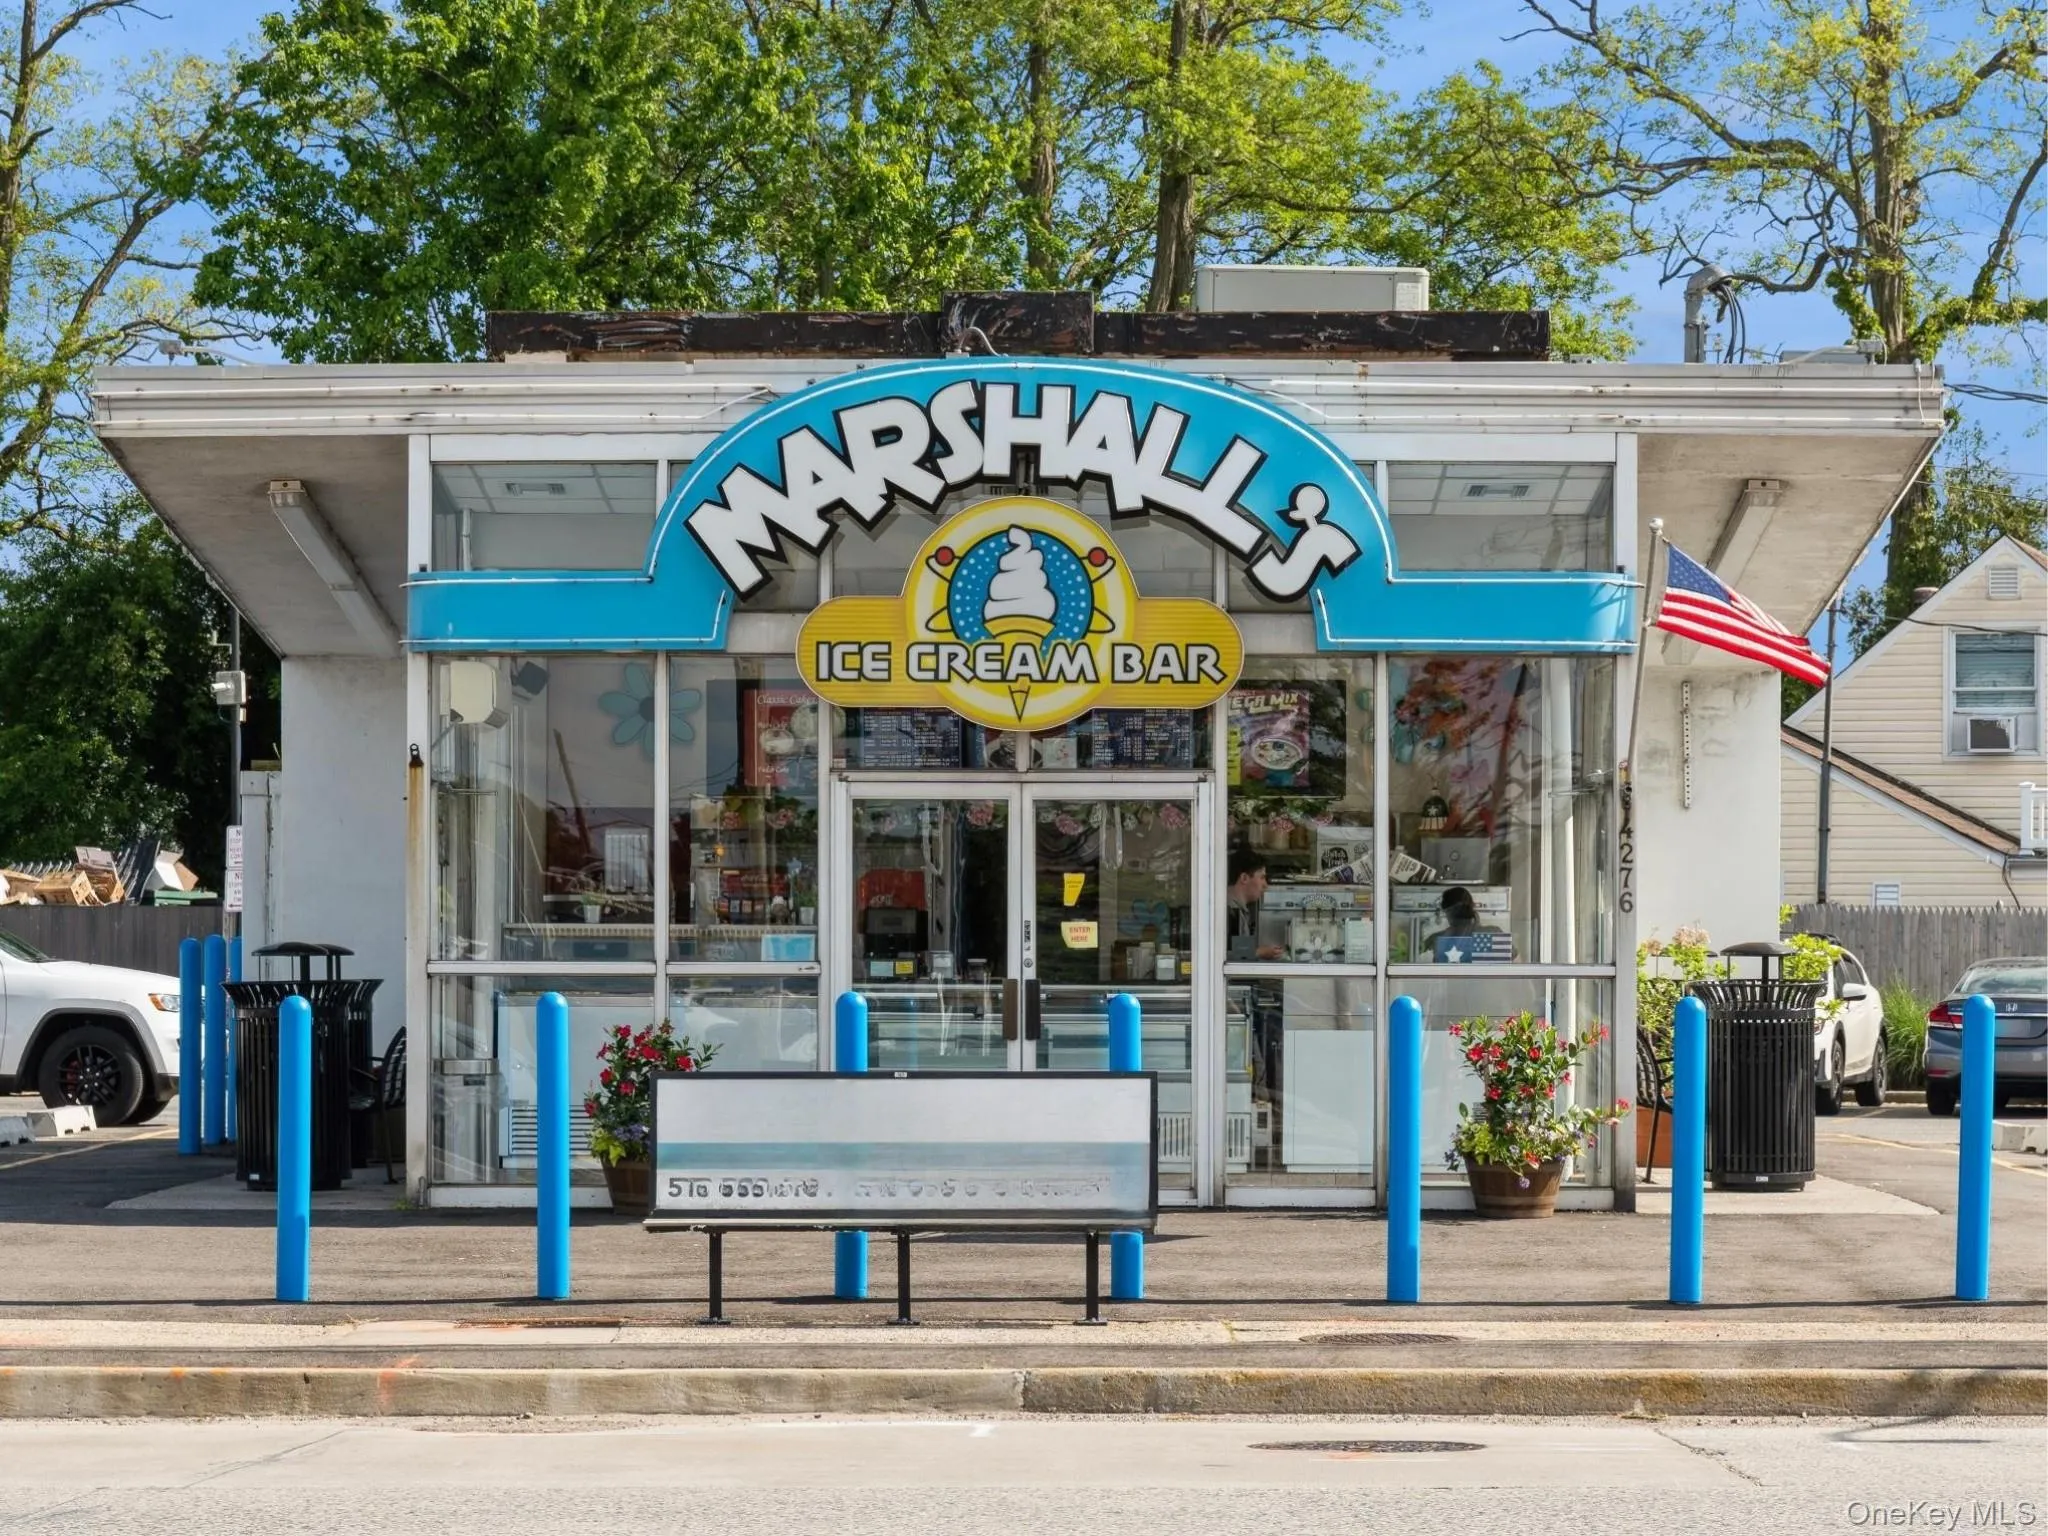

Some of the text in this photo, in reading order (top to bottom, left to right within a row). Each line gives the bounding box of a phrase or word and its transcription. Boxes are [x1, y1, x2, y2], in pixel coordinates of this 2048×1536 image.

[686, 379, 1362, 601] MARSHALL'S
[816, 641, 1228, 685] ICE CREAM BAR
[1229, 694, 1273, 714] EGA
[1069, 926, 1091, 934] ENTER
